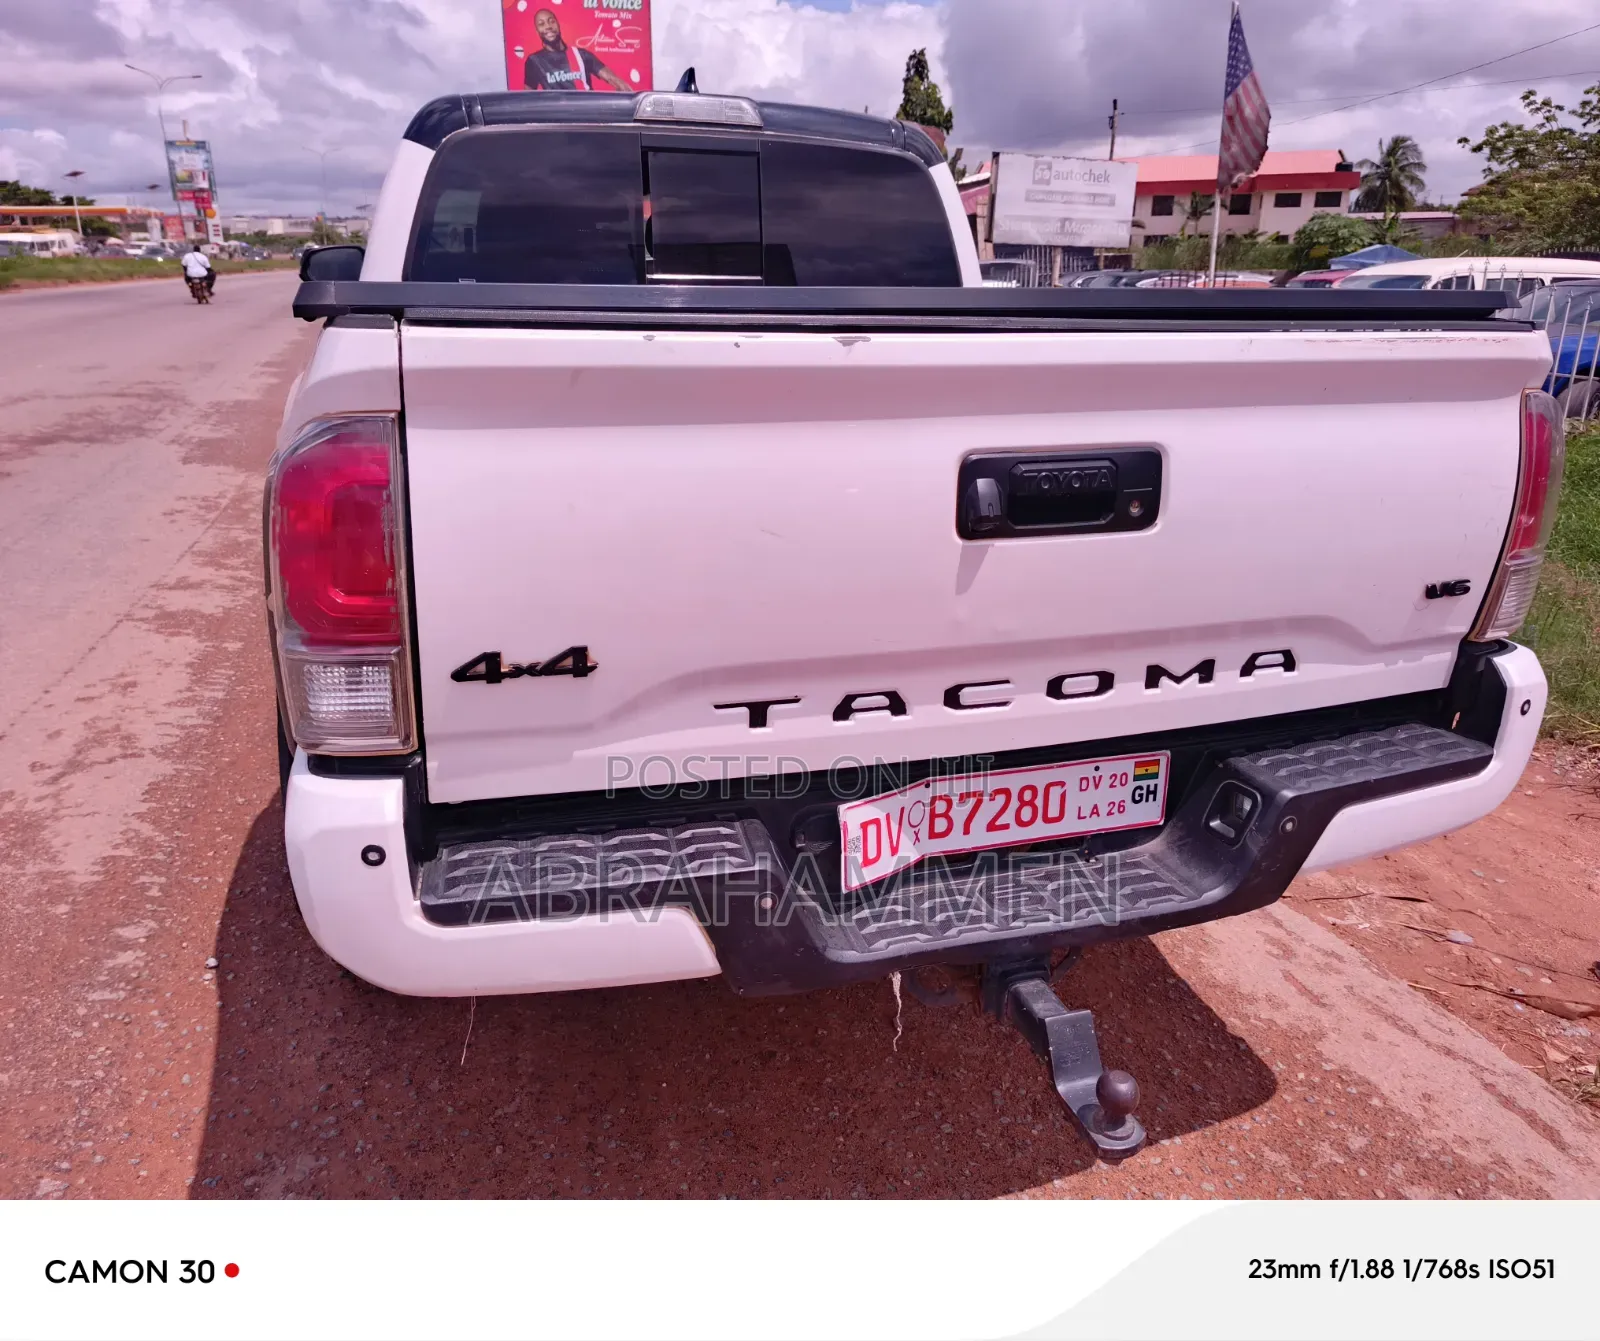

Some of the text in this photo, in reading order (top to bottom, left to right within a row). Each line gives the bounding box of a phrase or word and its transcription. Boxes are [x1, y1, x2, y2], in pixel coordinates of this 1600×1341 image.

[1053, 168, 1111, 184] autochek
[1021, 469, 1113, 494] TOYOTA
[1425, 579, 1471, 599] V6
[450, 645, 599, 684] 4x4
[713, 648, 1297, 729] TACOMA
[1079, 772, 1129, 792] DV 20
[1131, 783, 1159, 804] GH
[1077, 799, 1126, 820] LA 26
[860, 780, 1067, 868] DV B7280
